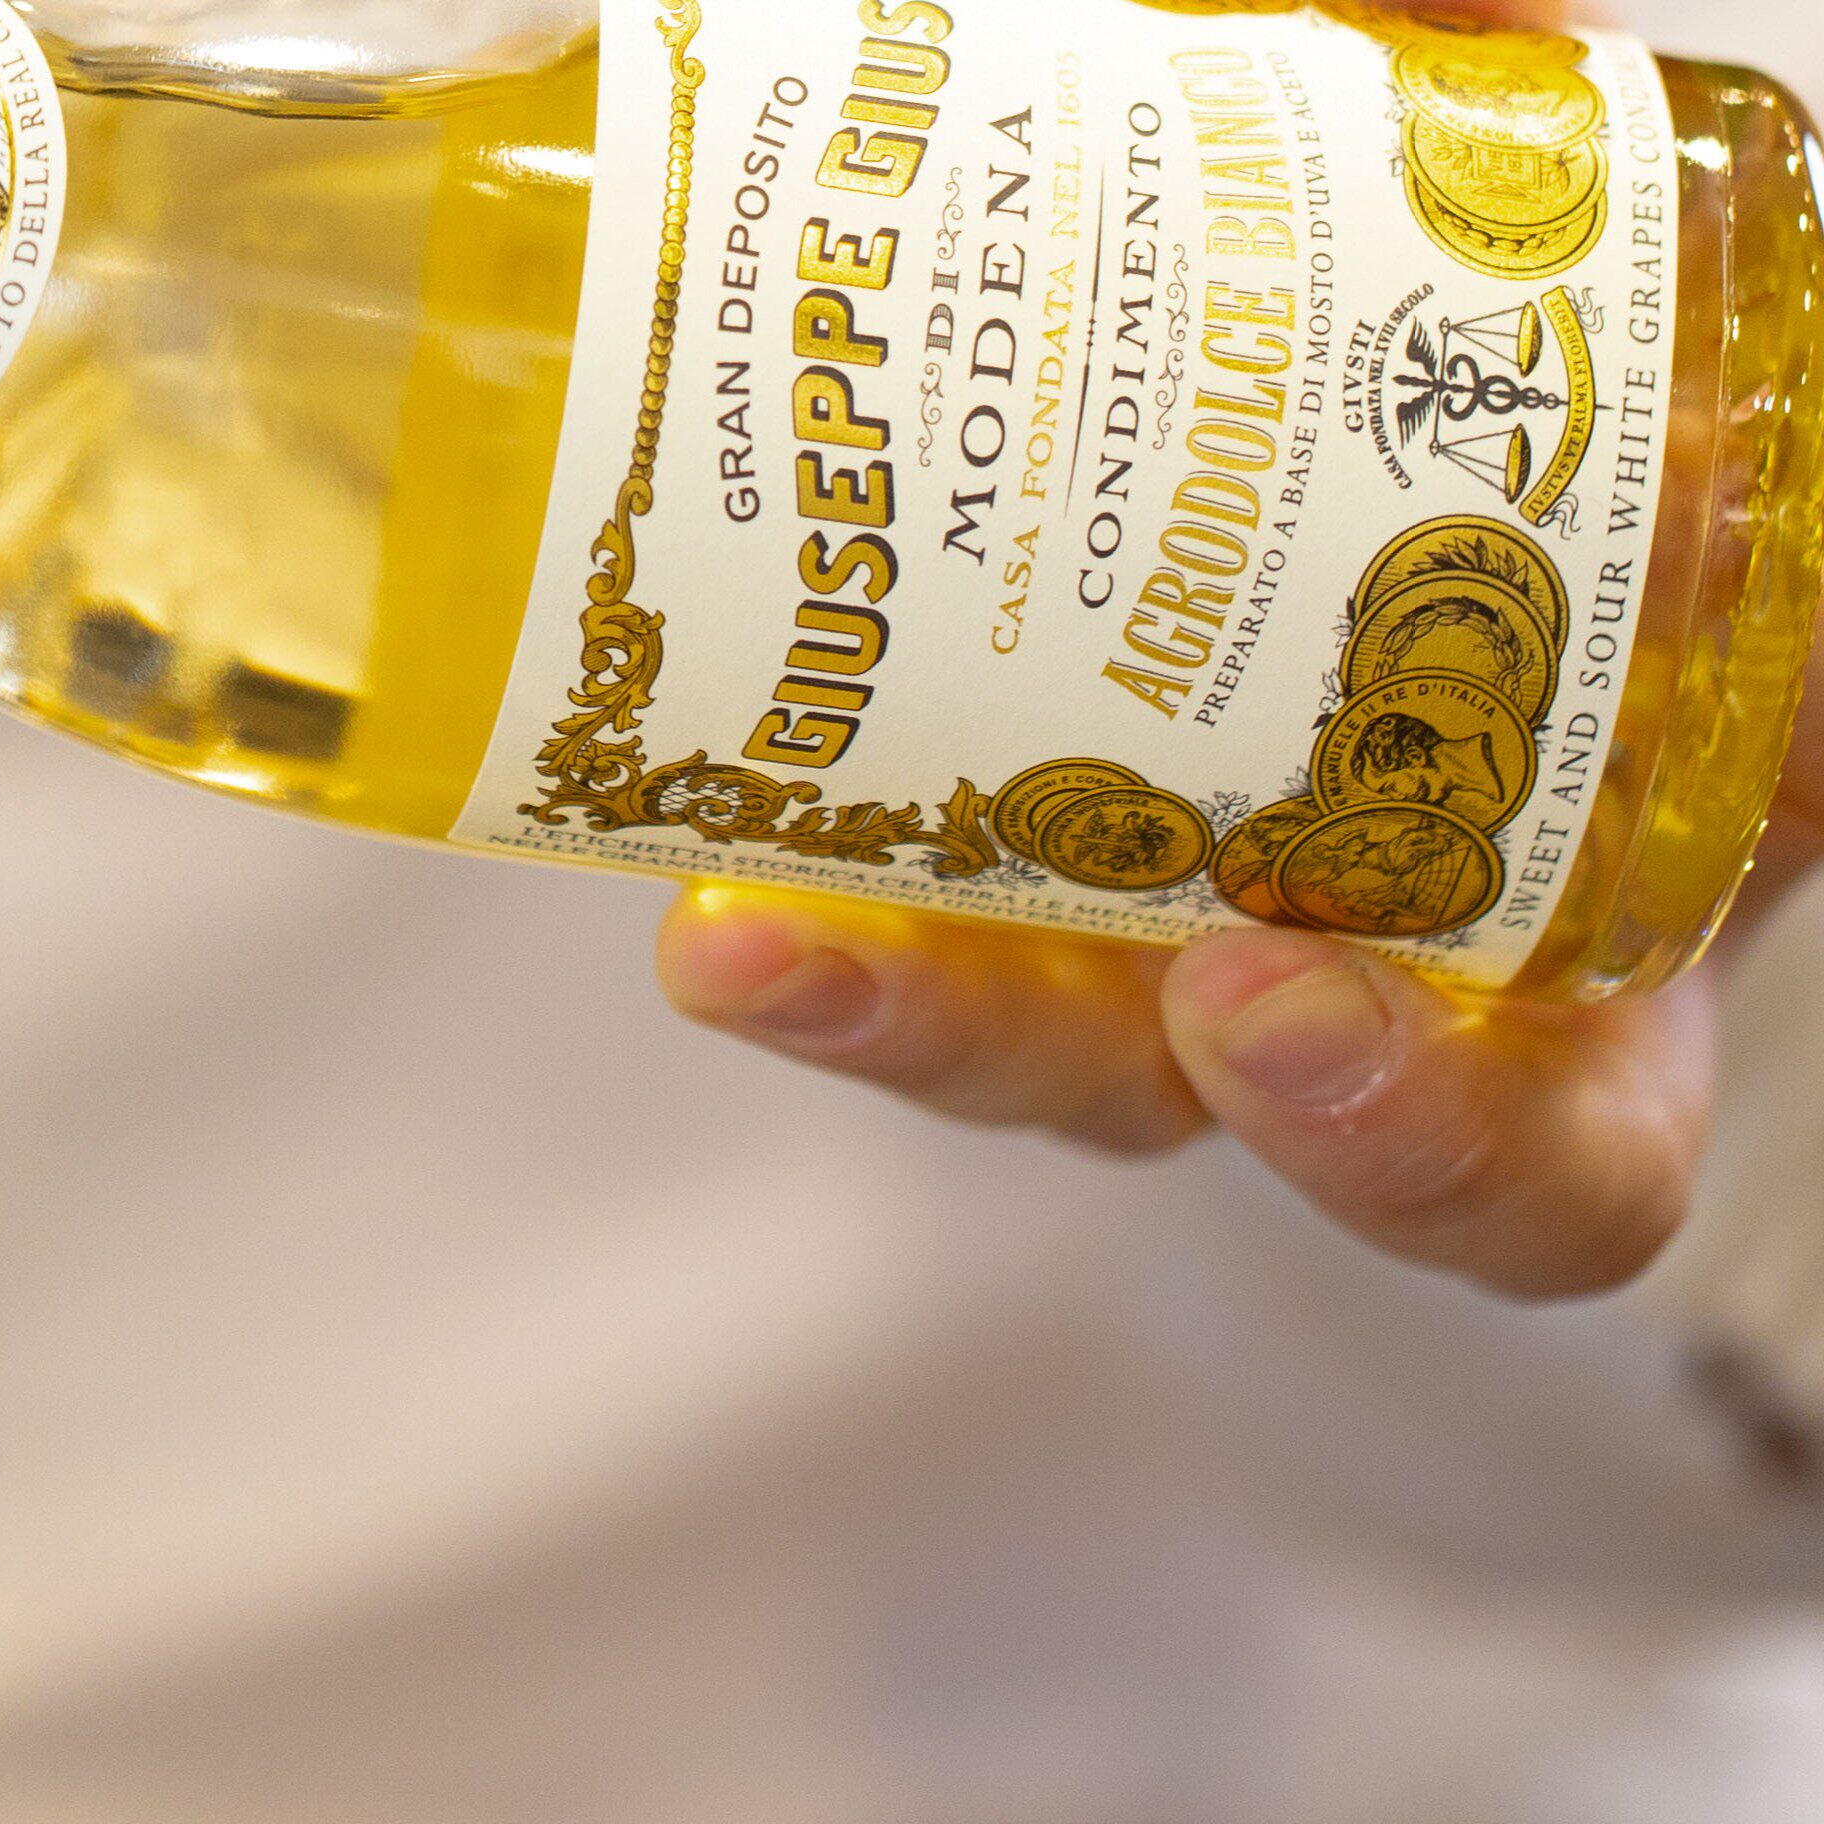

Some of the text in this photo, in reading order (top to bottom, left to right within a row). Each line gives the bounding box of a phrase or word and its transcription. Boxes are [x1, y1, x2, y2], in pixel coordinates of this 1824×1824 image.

[1, 46, 44, 133] REAL
[13, 142, 49, 267] DELLA
[1629, 179, 1663, 346] GRAPES
[715, 75, 808, 523] GRAN DEPOSITO
[924, 271, 959, 356] DI
[942, 106, 1034, 566] MODENA
[991, 50, 1081, 655] CASA FONDATA NEL 1605
[1078, 102, 1163, 609] CONDIMENTO
[1101, 46, 1297, 720] AGRODOLCE BIANCO
[1193, 51, 1334, 728] PREPARATO A BASE DI MOSTO D'UVA E ACETO
[1343, 319, 1376, 433] GIVSTI
[1367, 282, 1434, 490] CASA FONDATA NEL XVII SECOLO
[1570, 382, 1588, 437] PALMA
[742, 217, 899, 768] GIUSEPPE
[1528, 460, 1571, 514] IVSTVS
[1567, 438, 1582, 462] VT
[1608, 367, 1657, 538] WHITE
[1580, 557, 1633, 690] SOUR
[1361, 703, 1377, 718] II
[1382, 687, 1407, 706] RE
[1417, 683, 1497, 720] D'ITALIA
[1550, 710, 1600, 805] AND
[488, 833, 591, 856] NELLE
[596, 848, 725, 875] GRANDI
[522, 825, 723, 863] L'ETICHETTA
[731, 854, 868, 884] STORICA
[877, 875, 1018, 906] CELEBRA
[1026, 895, 1064, 913] LE
[1501, 819, 1570, 931] SWEET
